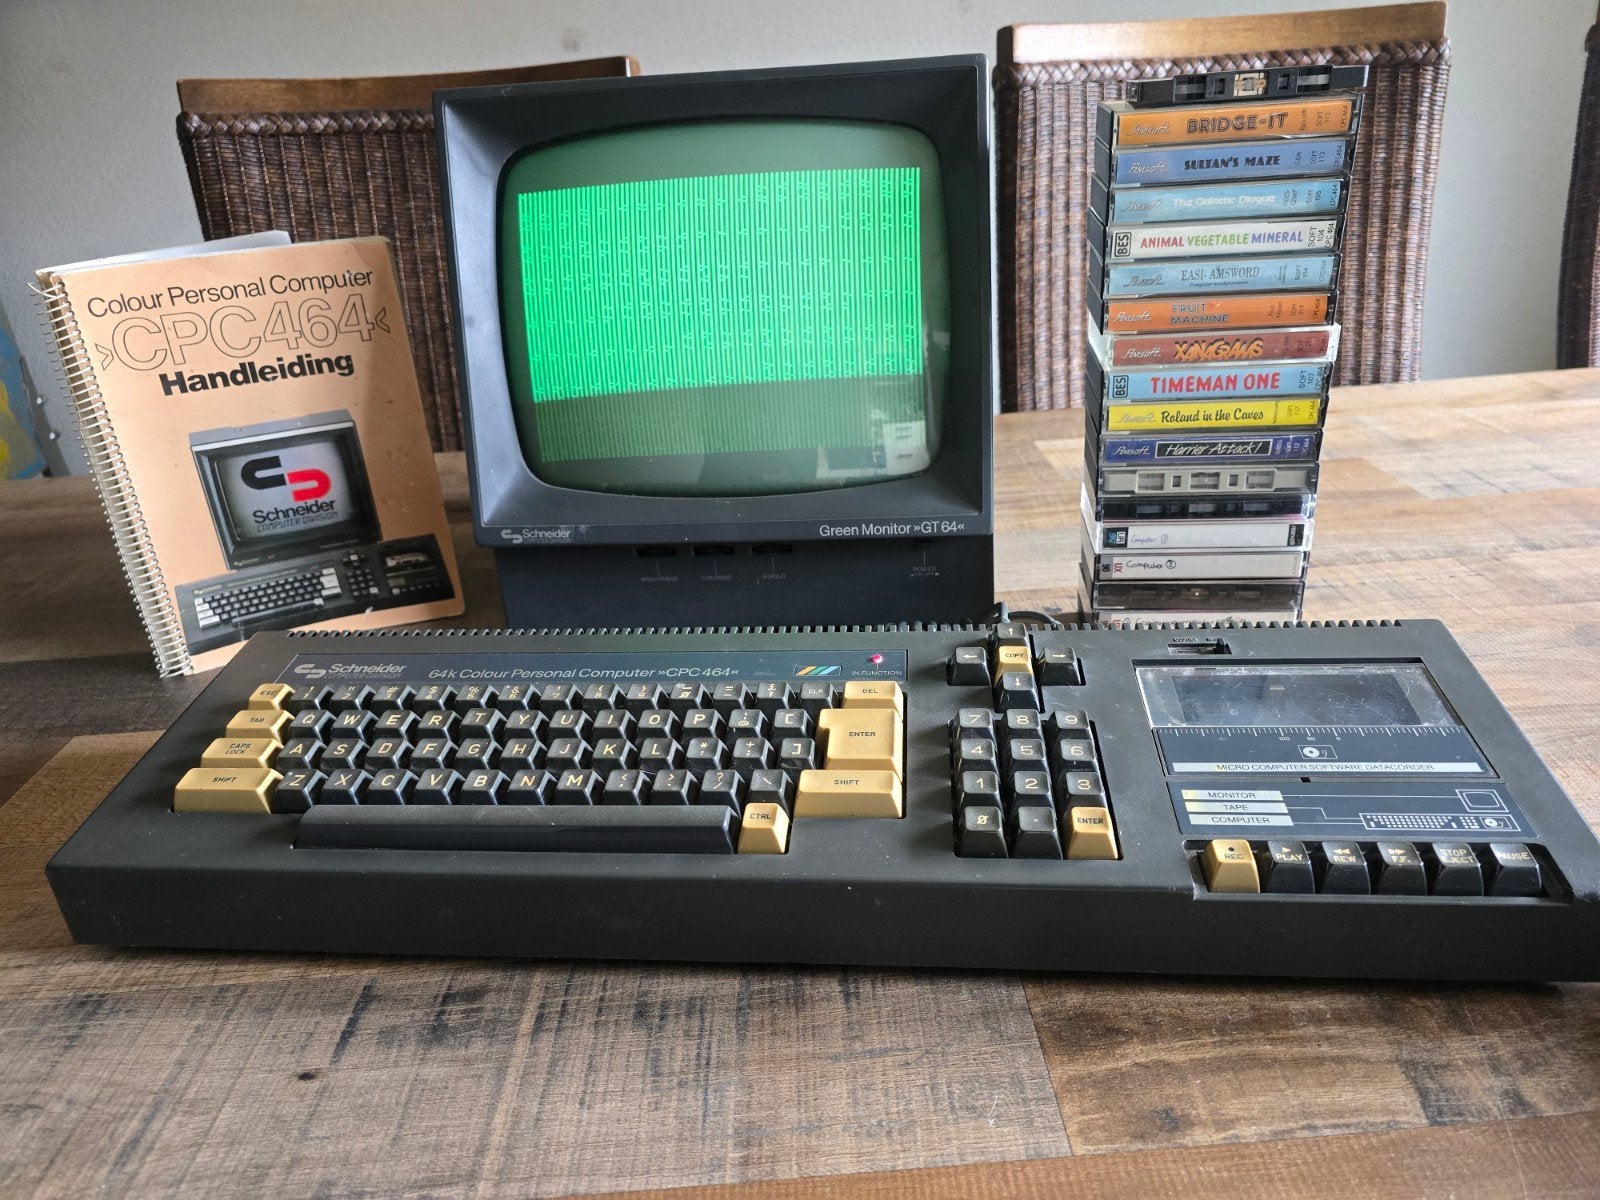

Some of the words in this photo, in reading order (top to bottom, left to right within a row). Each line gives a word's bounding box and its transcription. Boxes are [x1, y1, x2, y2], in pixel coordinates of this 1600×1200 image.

[1340, 105, 1348, 128] CPC464
[1187, 112, 1289, 134] BRIDGE-IT
[1334, 145, 1343, 168] CPC464
[1184, 157, 1239, 170] SULTAN'S
[1245, 155, 1280, 167] MAZE
[1140, 236, 1184, 249] ANIMAL
[1187, 233, 1249, 247] VEGETABLE
[1251, 231, 1303, 244] MINERAL
[1308, 226, 1317, 247] SOFT
[1317, 229, 1325, 242] 104
[1117, 234, 1129, 255] BES
[1209, 266, 1260, 280] AMSWORD
[88, 290, 164, 318] Colour
[168, 277, 266, 307] Personal
[269, 268, 374, 301] Computer
[1172, 303, 1206, 313] FRUIT
[1170, 314, 1229, 325] MACHINE
[1121, 346, 1161, 359] Amsoft
[159, 351, 356, 397] Handleiding
[1298, 370, 1307, 389] SOFT
[1307, 373, 1315, 385] 107
[1115, 377, 1127, 396] BES
[1150, 374, 1238, 394] TIMEMAN
[1243, 373, 1281, 390] ONE
[1161, 410, 1200, 423] Roland
[1202, 411, 1213, 420] in
[1215, 409, 1231, 421] the
[1234, 408, 1264, 420] Caves
[1112, 445, 1151, 456] Amsoft
[1165, 443, 1209, 456] Harrier
[1208, 441, 1262, 455] Attack!
[253, 500, 337, 524] Schneider
[257, 517, 301, 533] COMPUTER
[302, 511, 339, 525] DIVISION
[522, 528, 571, 539] Schneider
[819, 524, 859, 537] Green
[861, 522, 912, 536] Monitor
[1101, 564, 1111, 573] 90
[1113, 562, 1123, 573] UX
[1126, 559, 1164, 570] Computer
[329, 663, 407, 674] Schneider
[428, 669, 457, 679] 64k
[459, 668, 510, 679] Colour
[511, 668, 576, 679] Personal
[578, 667, 656, 680] Computer
[302, 714, 315, 724] Q
[343, 715, 360, 725] W
[386, 715, 401, 725] E
[428, 715, 443, 726] R
[474, 712, 486, 723] T
[519, 714, 531, 725] Y
[560, 714, 574, 725] U
[607, 714, 614, 725] I
[649, 714, 661, 725] O
[693, 714, 706, 724] P
[969, 714, 980, 724] 7
[1017, 715, 1029, 724] 8
[1065, 715, 1077, 725] 9
[289, 744, 303, 754] A
[333, 743, 349, 755] S
[378, 743, 393, 754] D
[423, 743, 437, 754] F
[468, 743, 481, 755] G
[512, 744, 527, 755] H
[559, 744, 571, 755] J
[603, 744, 617, 755] K
[651, 744, 661, 755] L
[971, 745, 984, 755] 4
[1020, 746, 1033, 755] 5
[1070, 746, 1084, 756] 6
[289, 775, 306, 786] Z
[334, 774, 351, 786] X
[381, 774, 395, 786] C
[430, 775, 443, 786] V
[473, 775, 488, 787] B
[519, 775, 536, 787] N
[566, 775, 584, 786] M
[976, 778, 984, 789] 1
[1024, 778, 1038, 789] 2
[1077, 779, 1091, 790] 3
[1076, 817, 1104, 825] ENTER
[1211, 816, 1271, 824] COMPUTER
[1275, 853, 1303, 862] PLAY
[1440, 848, 1467, 857] STOP
[1498, 851, 1530, 861] PAUSE
[1333, 855, 1356, 863] REW
[1440, 855, 1475, 864] EJECT
